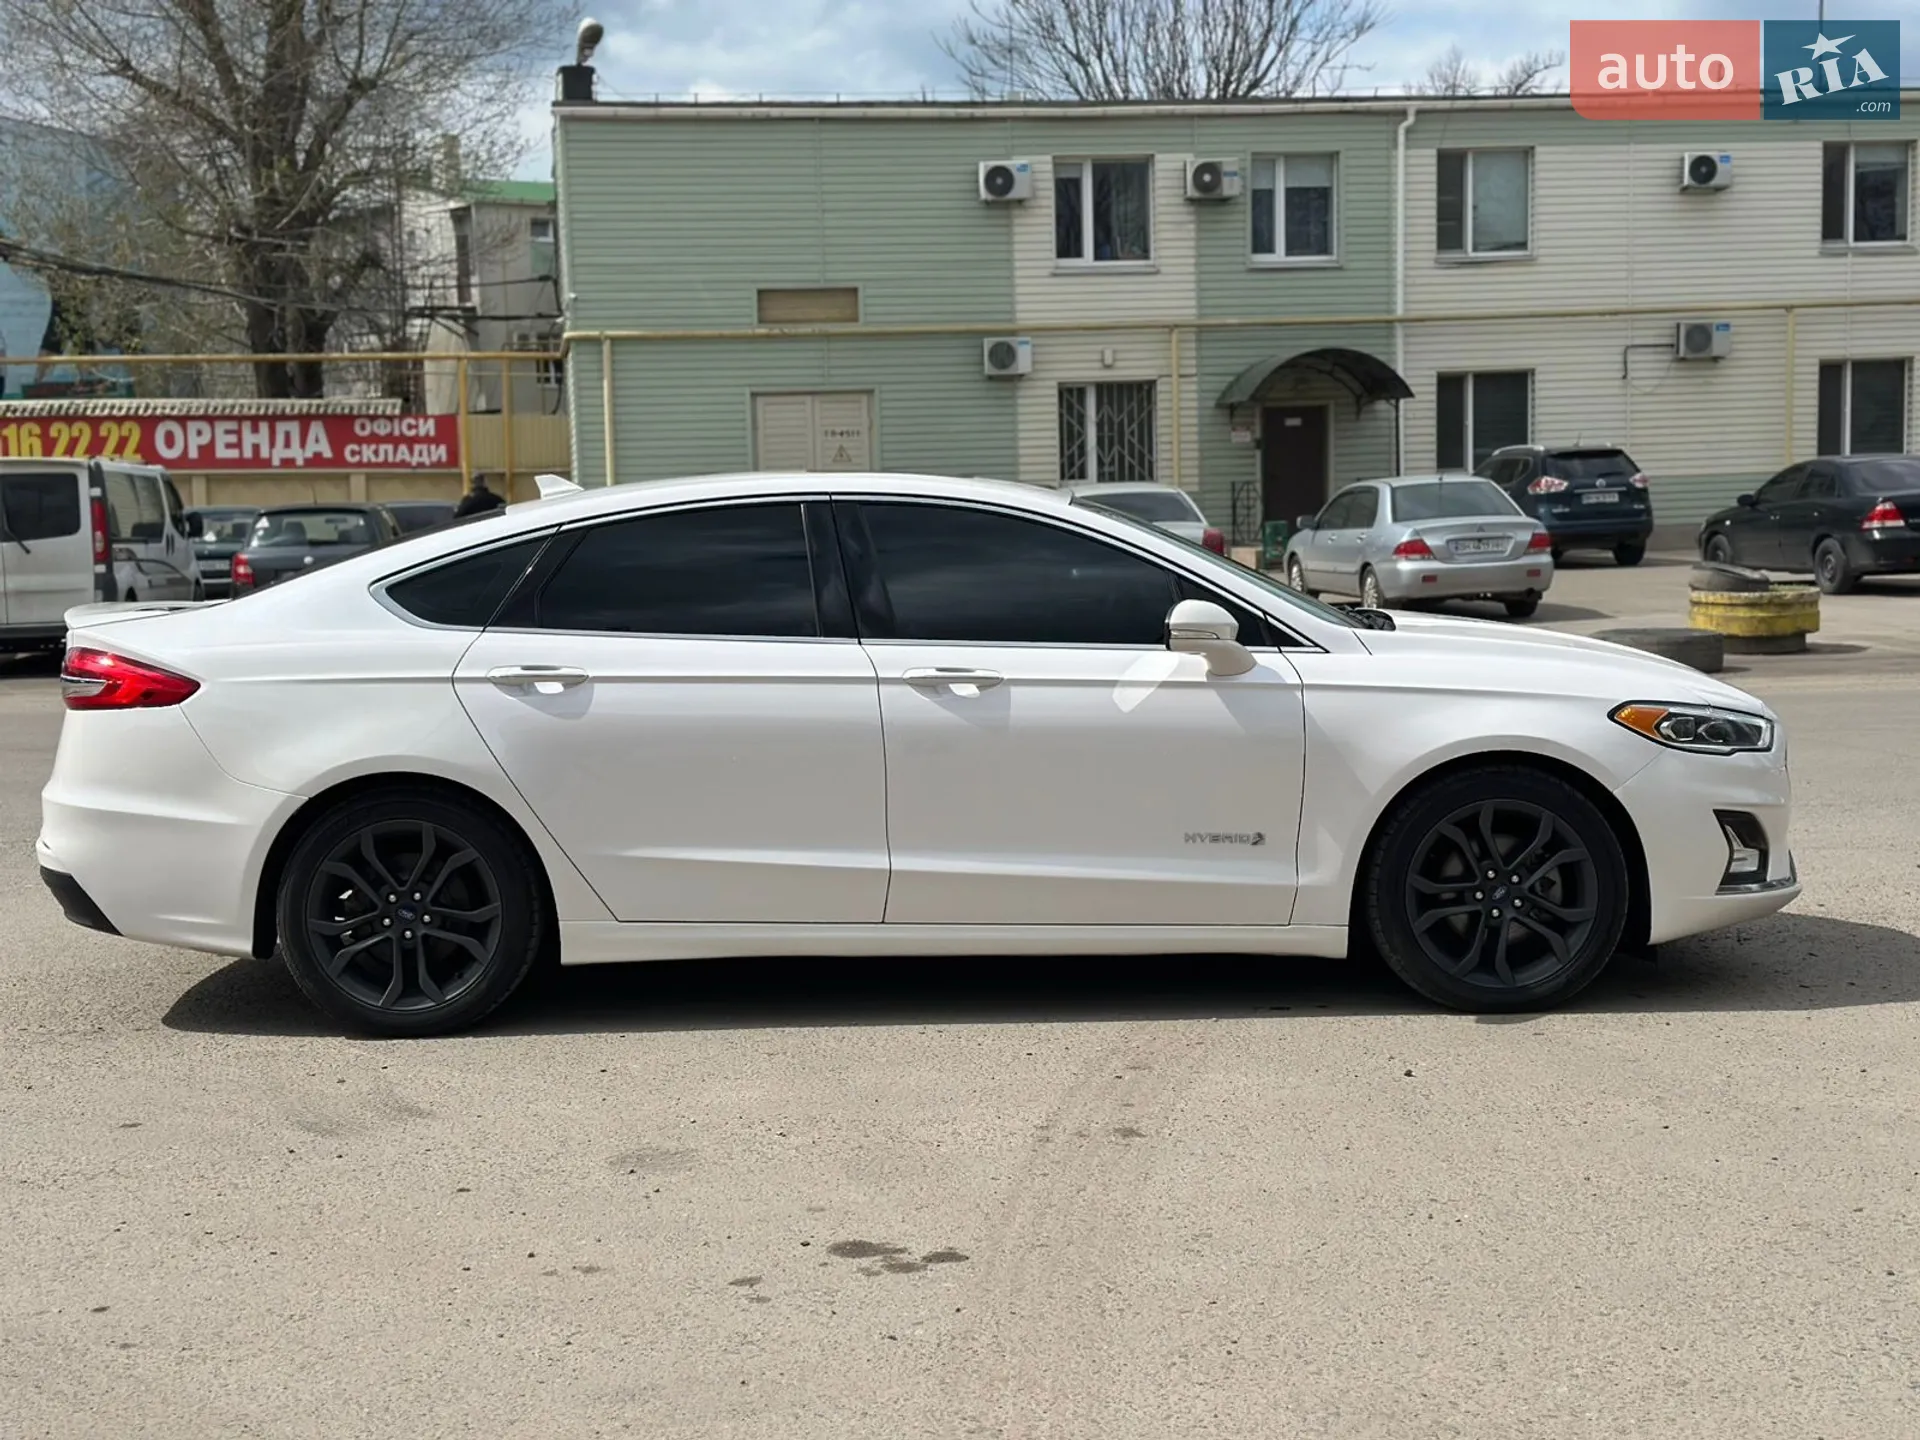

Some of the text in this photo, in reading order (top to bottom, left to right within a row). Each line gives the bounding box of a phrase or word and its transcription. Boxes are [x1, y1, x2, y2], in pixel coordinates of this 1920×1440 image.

[354, 417, 435, 437] ОФІСИ
[50, 421, 91, 458] 22
[100, 421, 143, 461] 22
[154, 419, 333, 467] ОРЕНДА
[344, 443, 447, 466] СКЛАДИ
